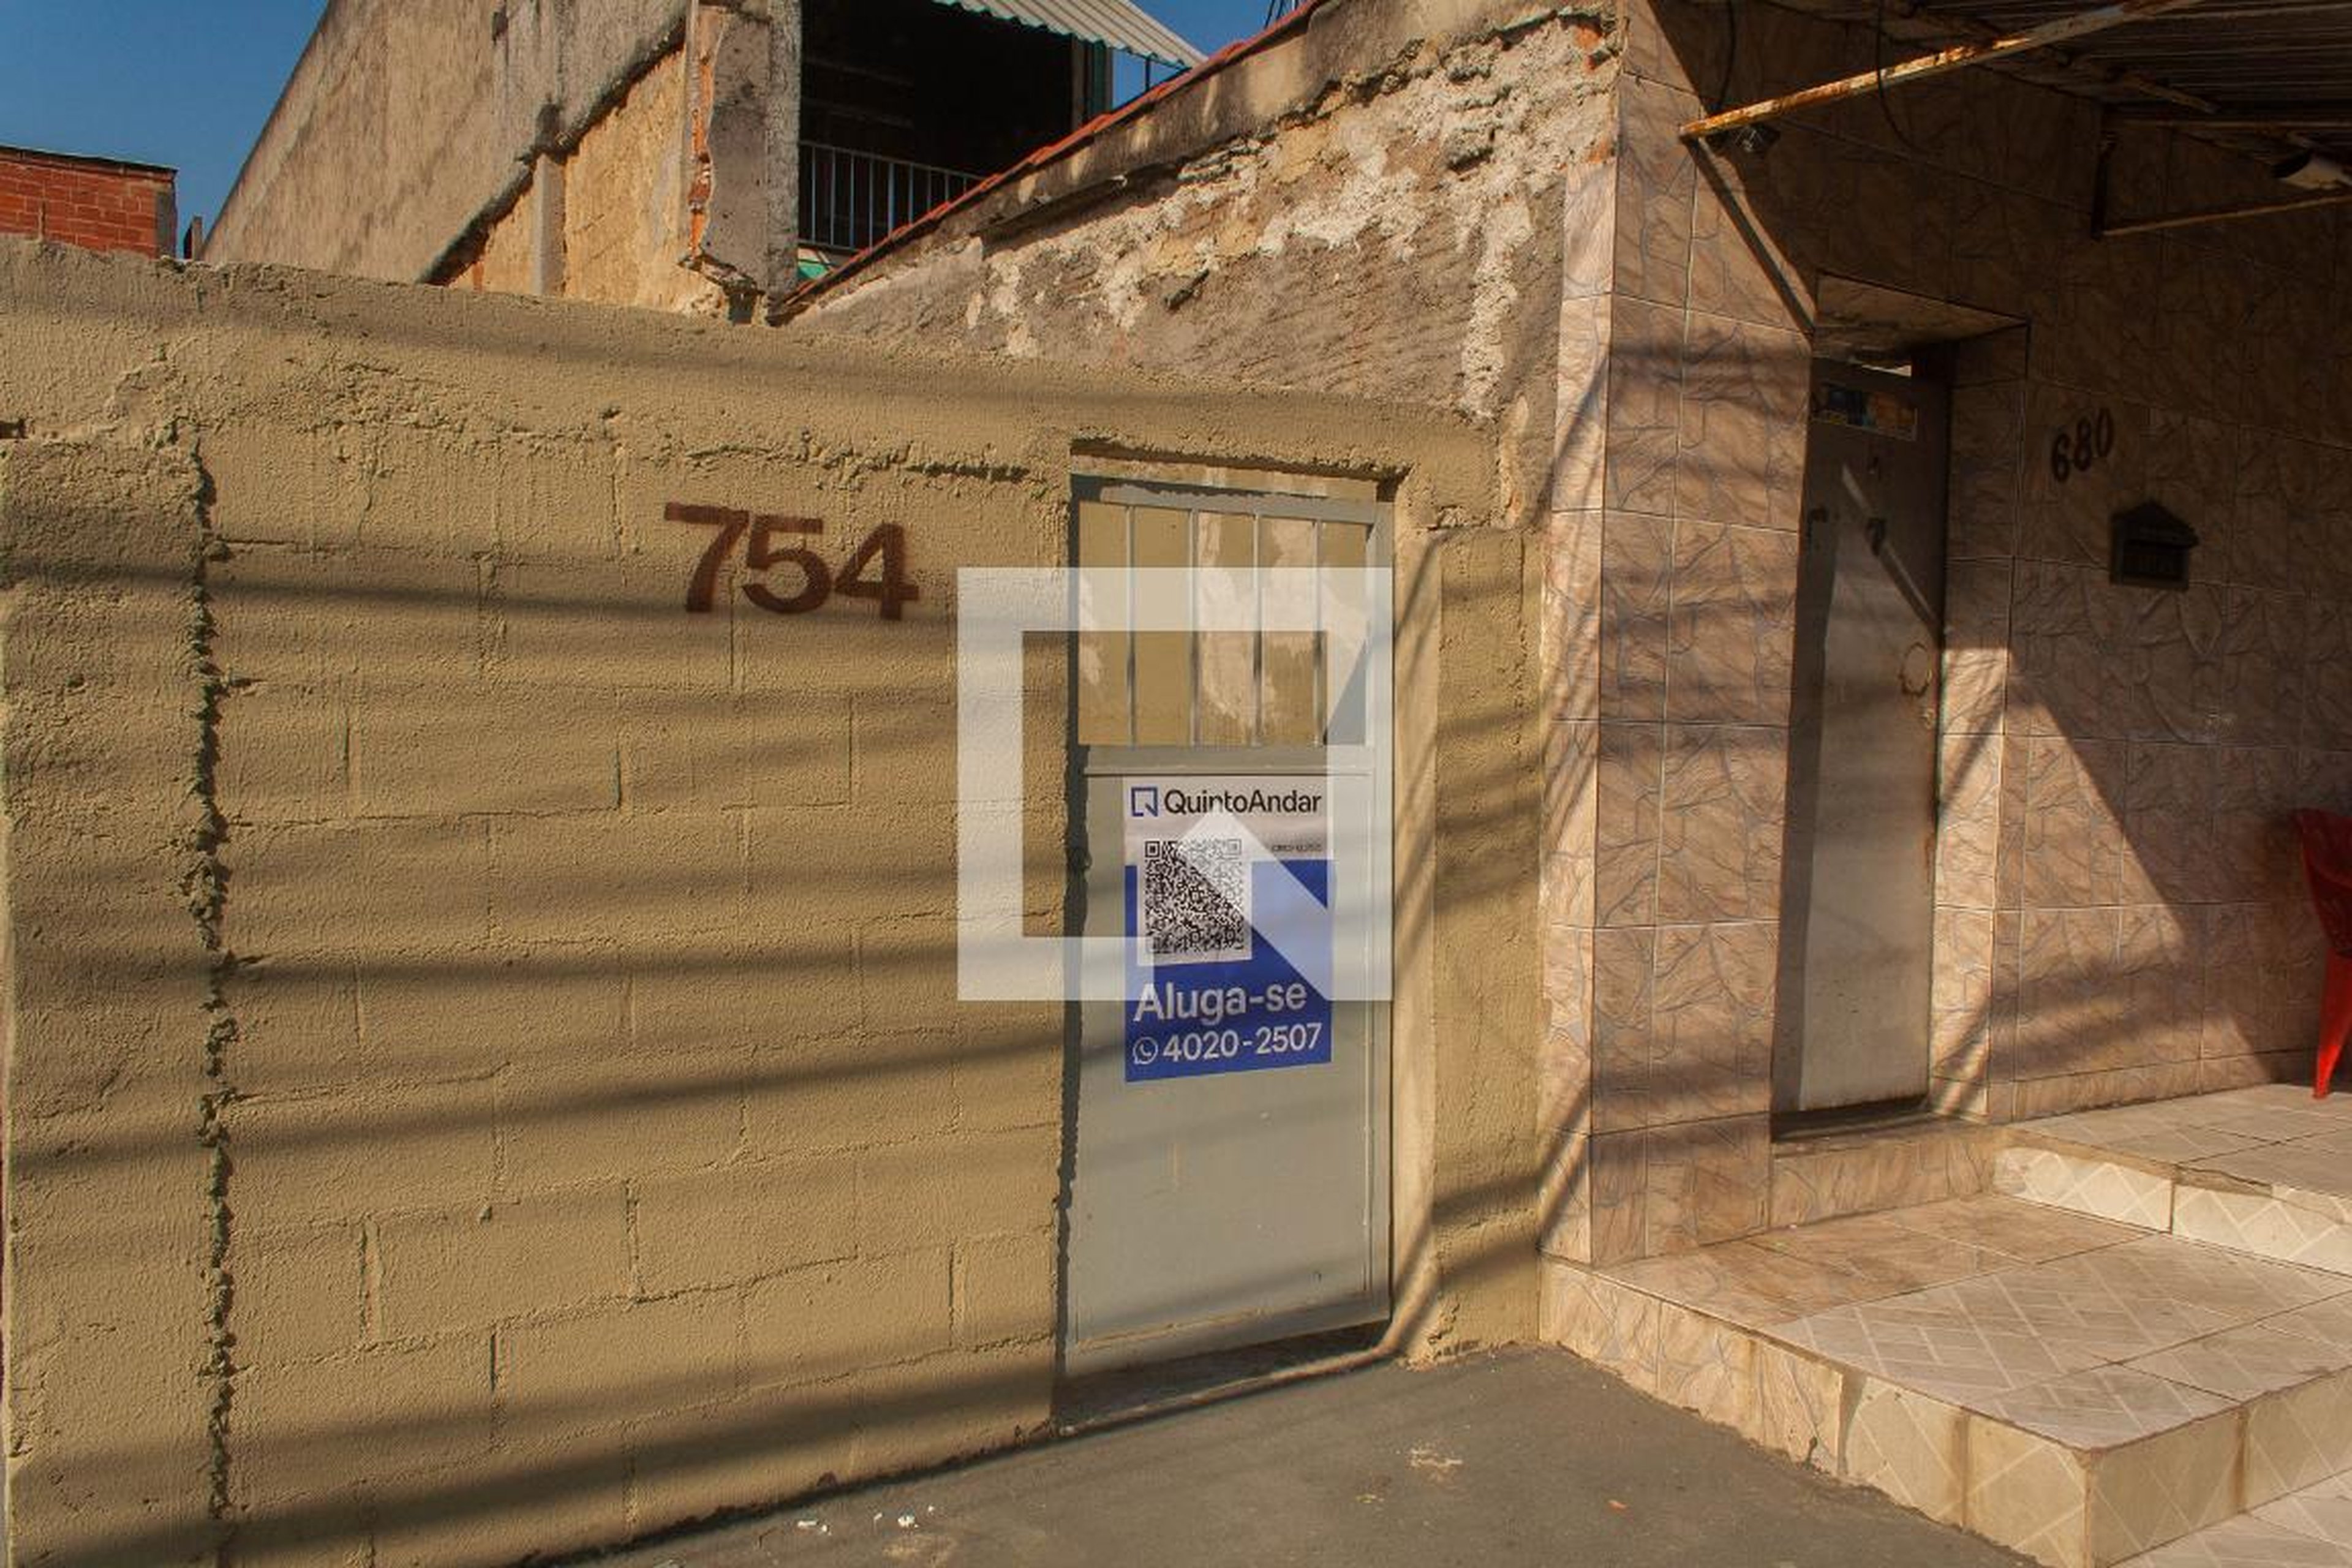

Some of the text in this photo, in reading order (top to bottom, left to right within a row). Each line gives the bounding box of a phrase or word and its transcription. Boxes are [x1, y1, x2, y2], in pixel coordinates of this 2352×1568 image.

[2052, 409, 2114, 482] 680
[664, 502, 919, 620] 754
[1164, 789, 1322, 815] QuintoAndar
[1133, 982, 1308, 1026] Aluga-se
[1163, 1023, 1322, 1062] 4020-2507
